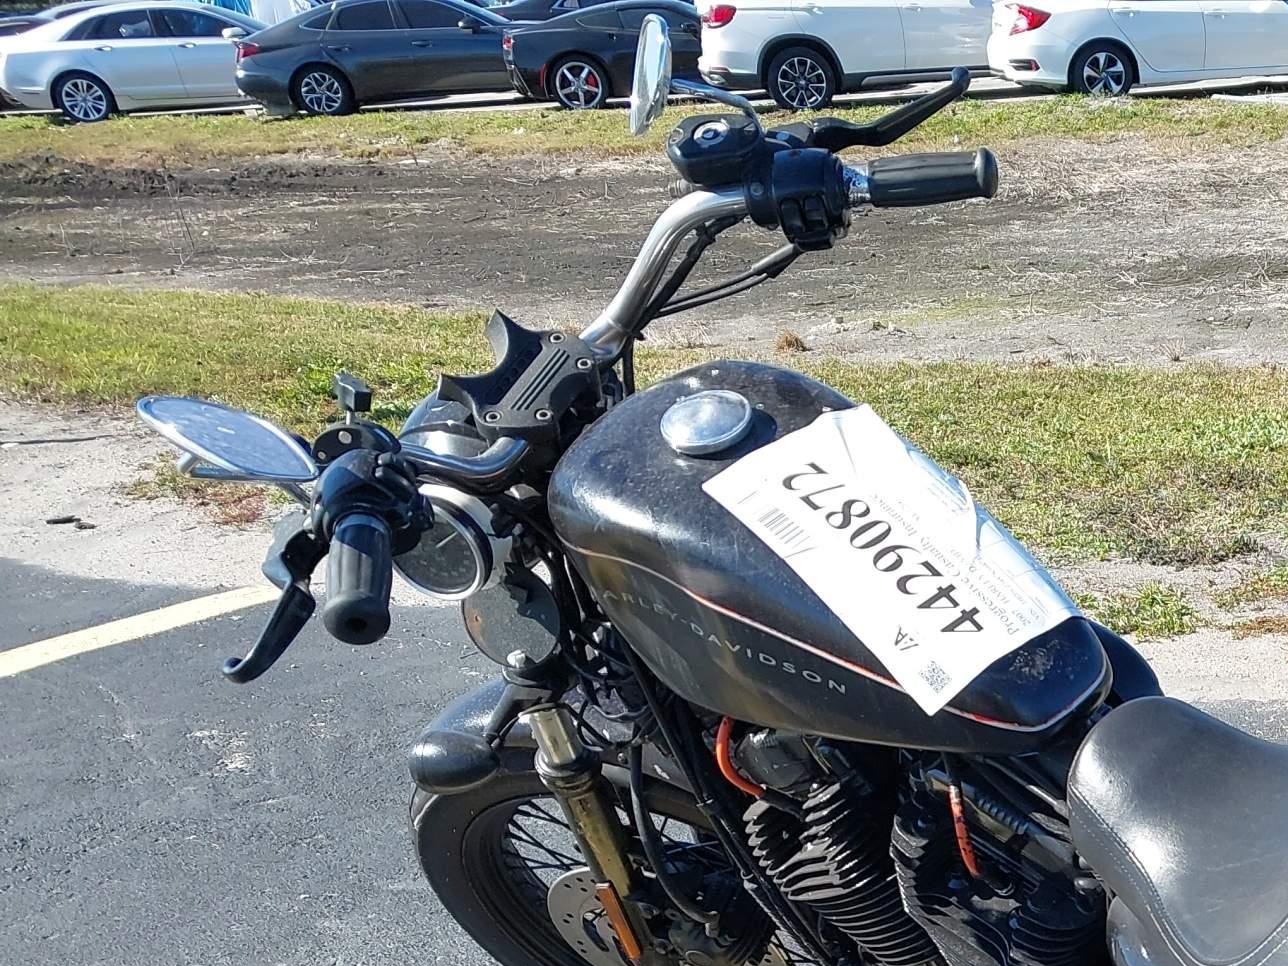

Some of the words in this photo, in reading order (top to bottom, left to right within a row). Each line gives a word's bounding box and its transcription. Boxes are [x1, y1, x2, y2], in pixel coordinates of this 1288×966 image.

[781, 460, 983, 630] 44290872
[919, 535, 960, 578] Casualty
[959, 575, 1020, 636] Progressive
